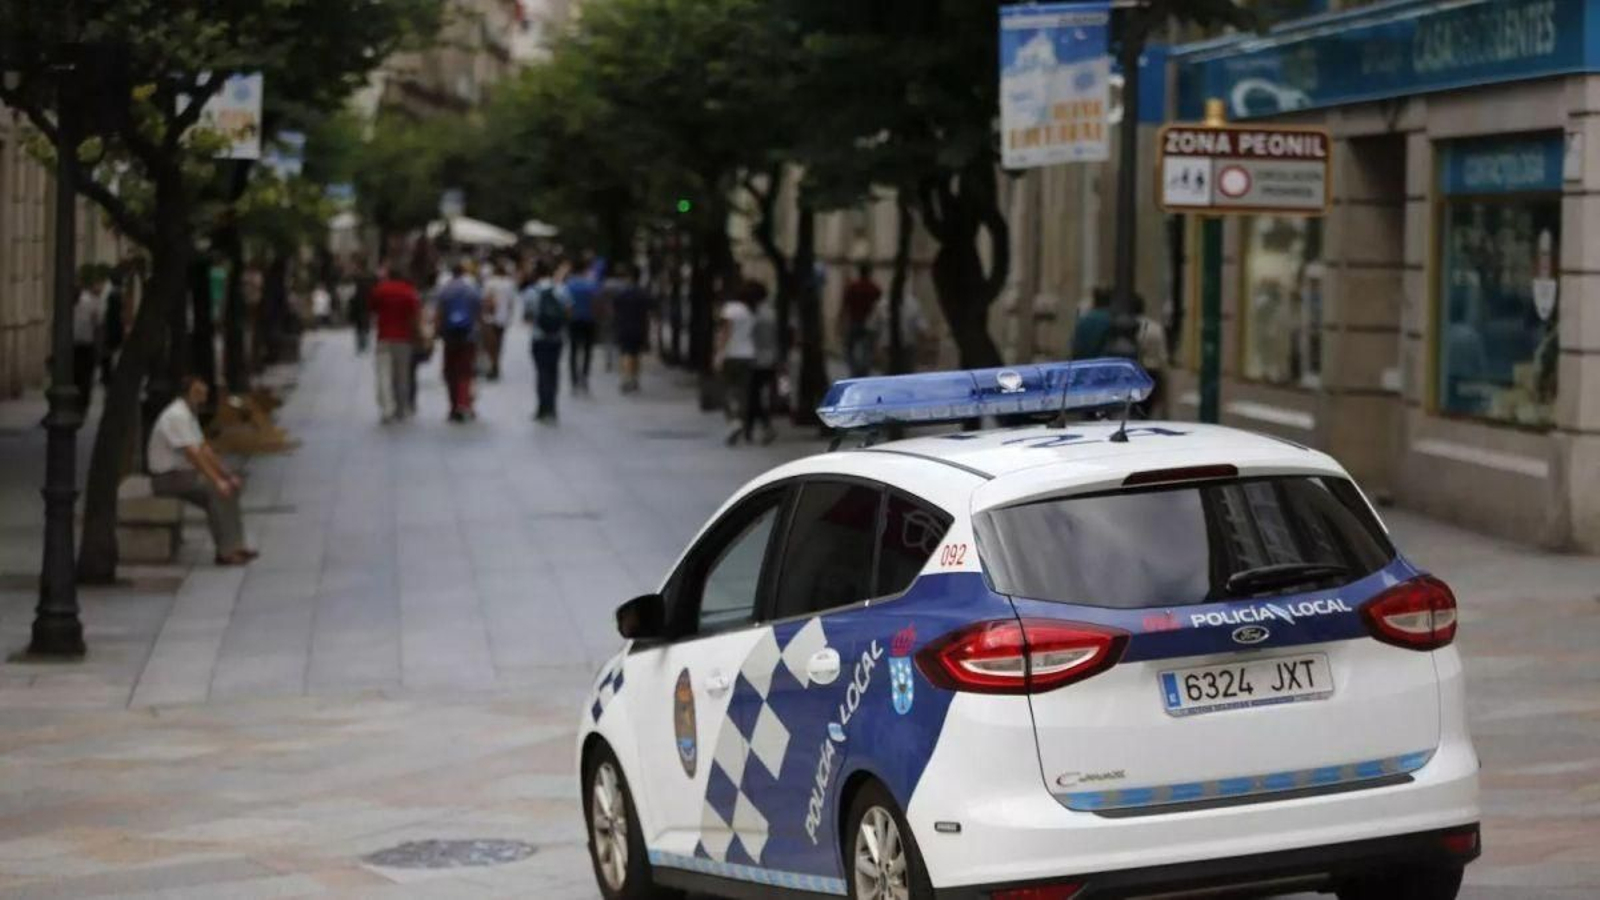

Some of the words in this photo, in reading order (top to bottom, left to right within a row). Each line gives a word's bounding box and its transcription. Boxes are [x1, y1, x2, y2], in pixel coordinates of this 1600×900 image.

[1165, 131, 1232, 154] ZONA
[1238, 133, 1327, 157] PEONIL
[941, 544, 967, 566] 092
[1190, 604, 1275, 628] POLICÍA
[1288, 599, 1353, 618] LOCAL
[840, 639, 883, 725] LOCAL
[1184, 668, 1254, 701] 6324
[1271, 660, 1315, 692] JXT
